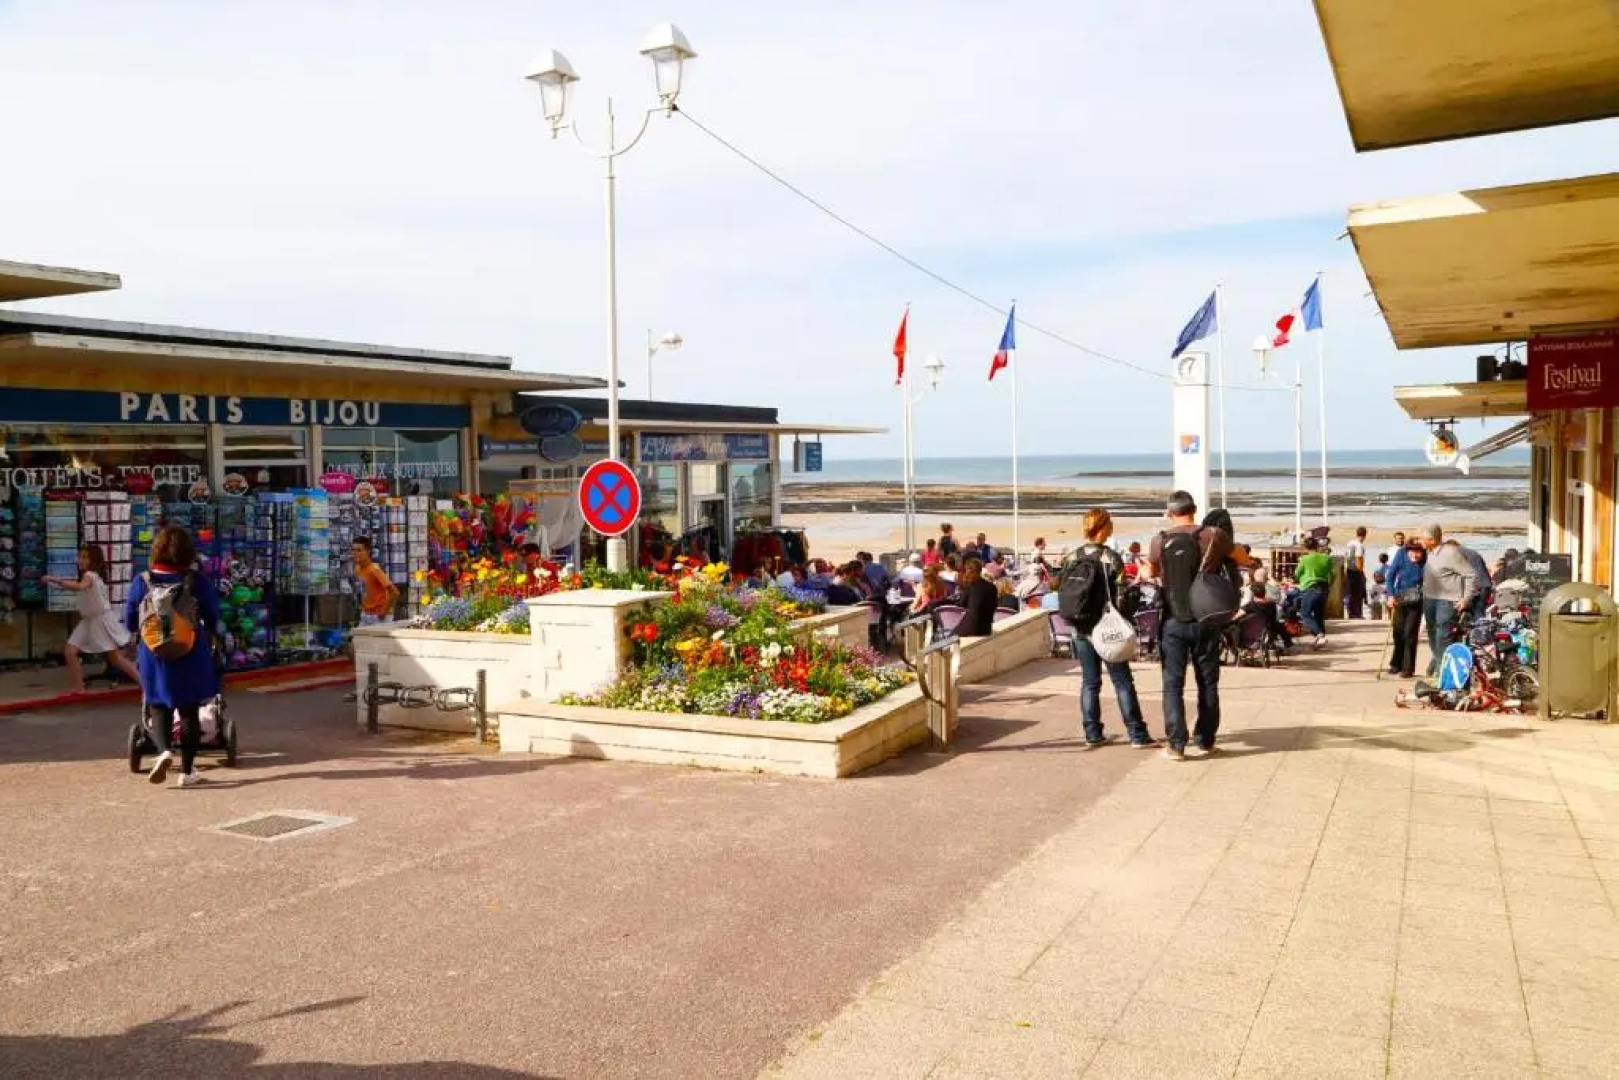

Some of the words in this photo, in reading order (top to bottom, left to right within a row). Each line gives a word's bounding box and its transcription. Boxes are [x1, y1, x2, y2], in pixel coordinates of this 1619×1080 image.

[1543, 361, 1601, 390] Festival
[120, 391, 244, 424] PARIS
[290, 398, 381, 426] BIJOU
